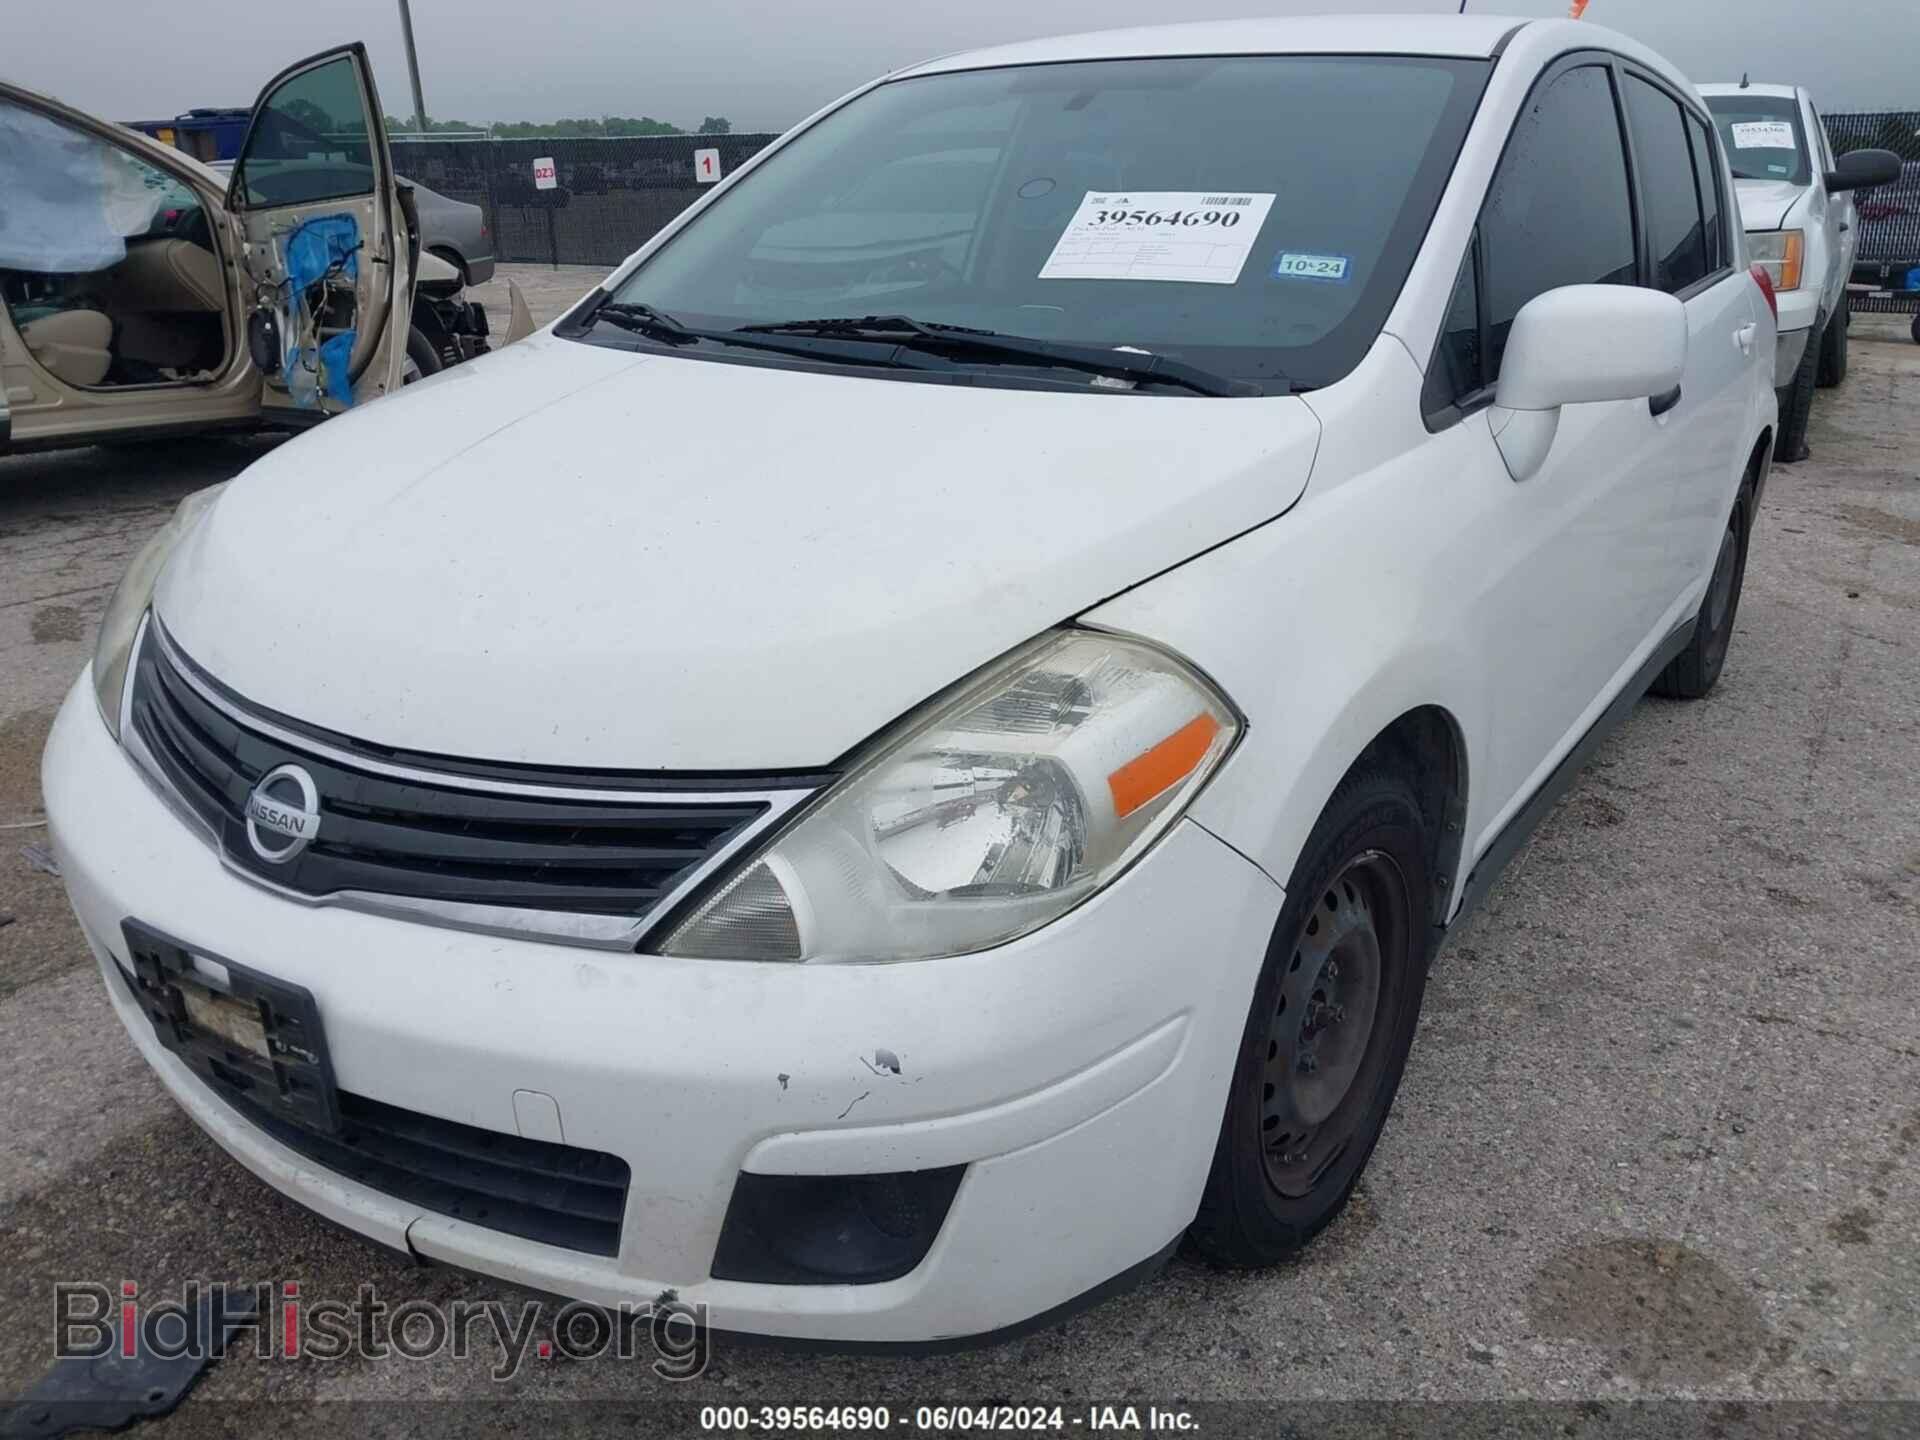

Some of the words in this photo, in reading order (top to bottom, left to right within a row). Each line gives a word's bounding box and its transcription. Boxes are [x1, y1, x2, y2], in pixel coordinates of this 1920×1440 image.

[702, 157, 712, 174] 1
[1088, 209, 1241, 228] 39564690
[249, 795, 306, 833] NISSAN
